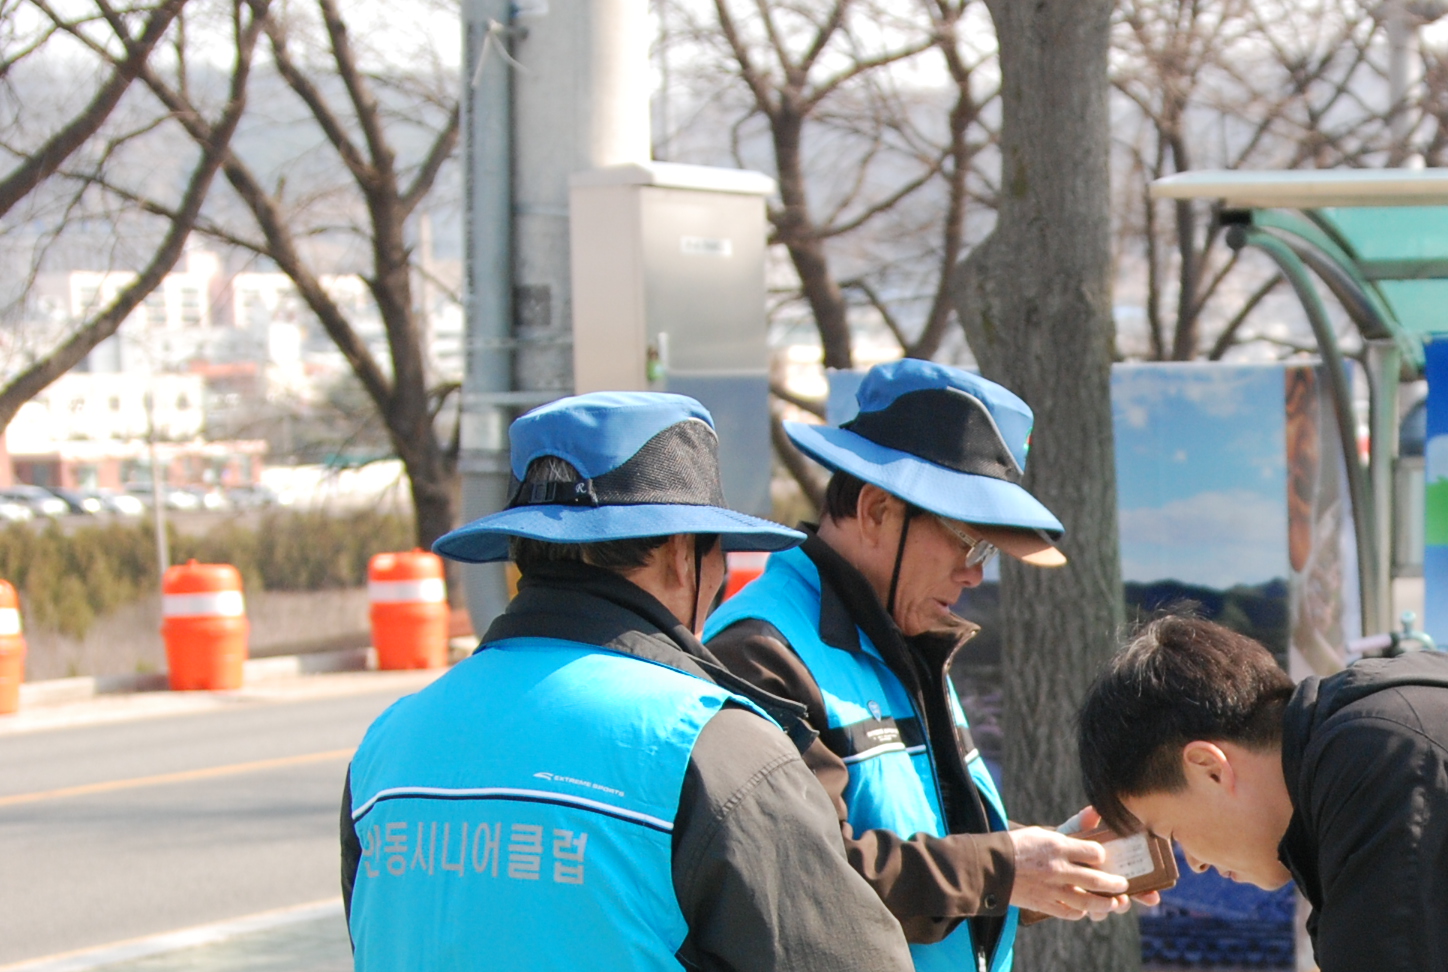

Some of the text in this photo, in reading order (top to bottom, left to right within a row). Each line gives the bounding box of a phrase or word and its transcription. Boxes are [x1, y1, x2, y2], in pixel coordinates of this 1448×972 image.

[553, 775, 625, 798] EXTREME SPORTS
[361, 821, 588, 885] 안동시니어클럽
